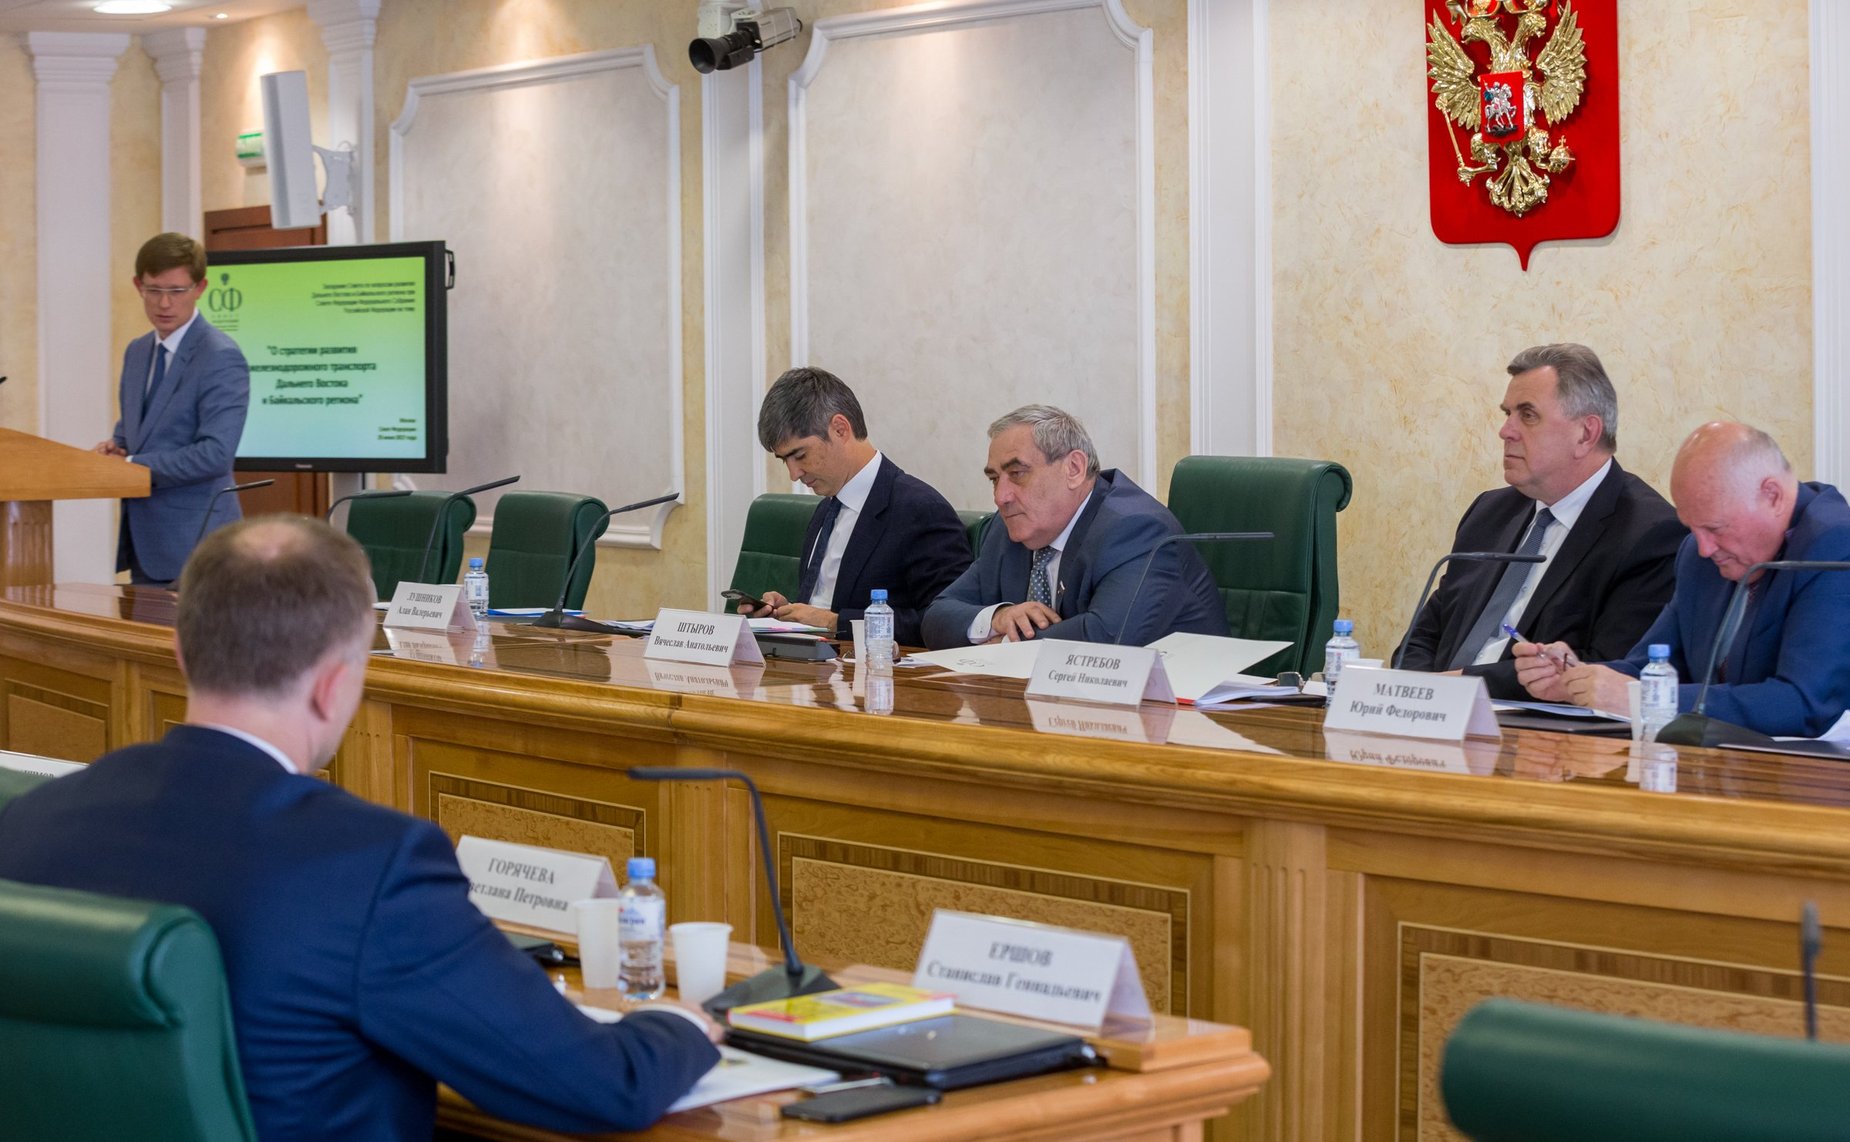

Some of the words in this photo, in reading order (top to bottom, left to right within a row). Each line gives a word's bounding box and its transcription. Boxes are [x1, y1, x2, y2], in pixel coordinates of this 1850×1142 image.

[208, 287, 243, 313] СФ
[315, 378, 349, 388] Востока
[411, 606, 443, 620] Валерьевич
[676, 621, 716, 636] ШТЫРОВ
[653, 635, 685, 648] Вячеслав
[684, 639, 729, 654] Анатольевич
[1065, 653, 1121, 671] ЯСТРЕБОВ
[1047, 669, 1077, 684] Сергей
[1077, 671, 1129, 689] Николаевич
[1370, 682, 1435, 701] МАТВЕЕВ
[1349, 699, 1384, 717] Юрий
[1385, 703, 1447, 723] Федорович
[487, 857, 555, 885] ГОРЯЧЕВА
[468, 880, 513, 900] ветлана
[513, 886, 569, 912] Петровна
[988, 941, 1054, 967] ЕРШОВ
[926, 959, 1002, 988] Станислав
